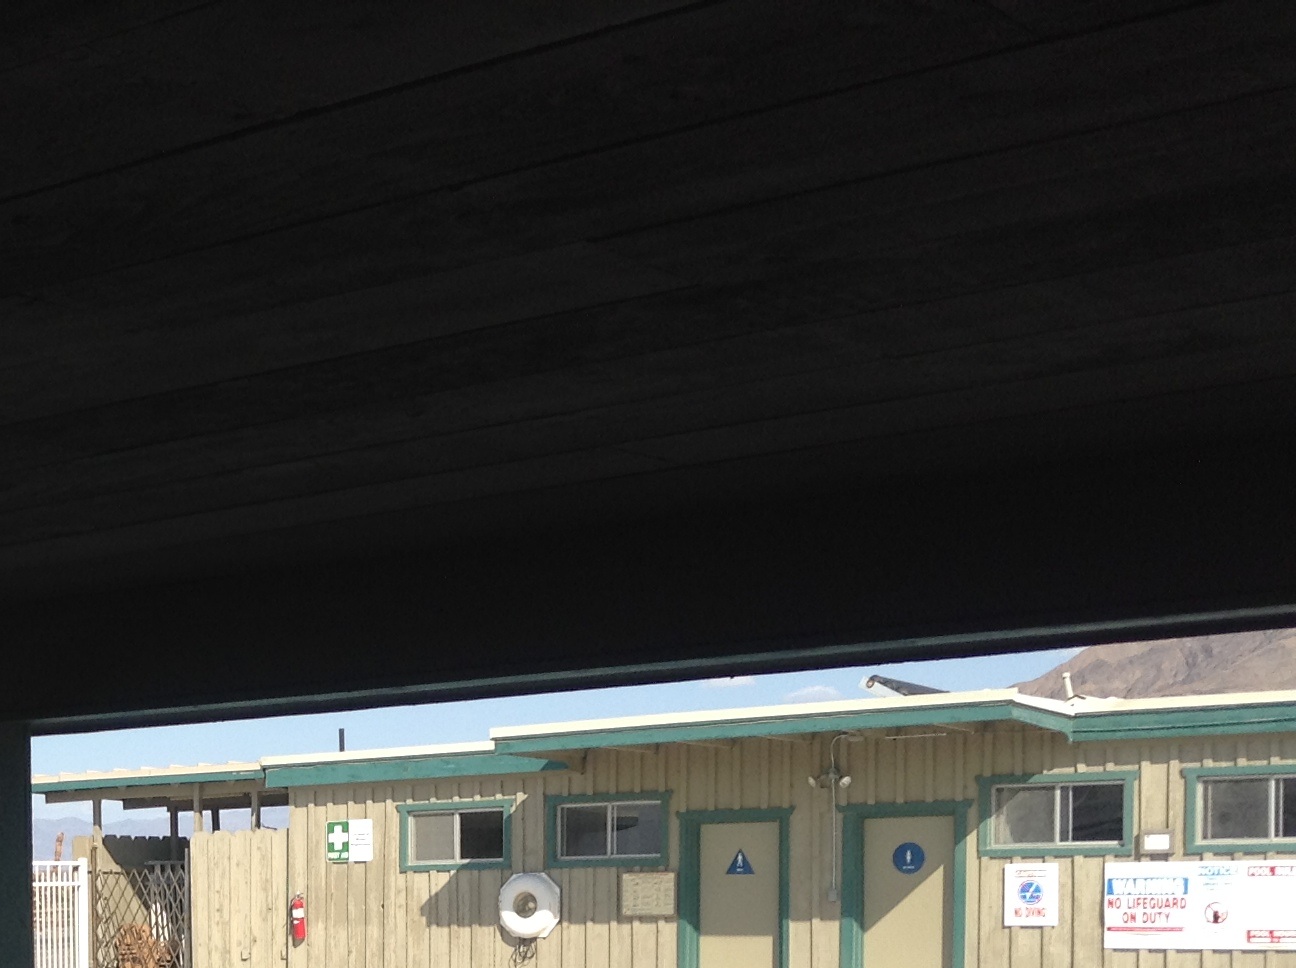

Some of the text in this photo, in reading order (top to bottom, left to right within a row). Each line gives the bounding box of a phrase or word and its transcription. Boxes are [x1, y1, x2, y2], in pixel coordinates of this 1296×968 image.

[1107, 897, 1187, 909] NO LIFEGUARD
[1122, 912, 1171, 924] ON DUTY
